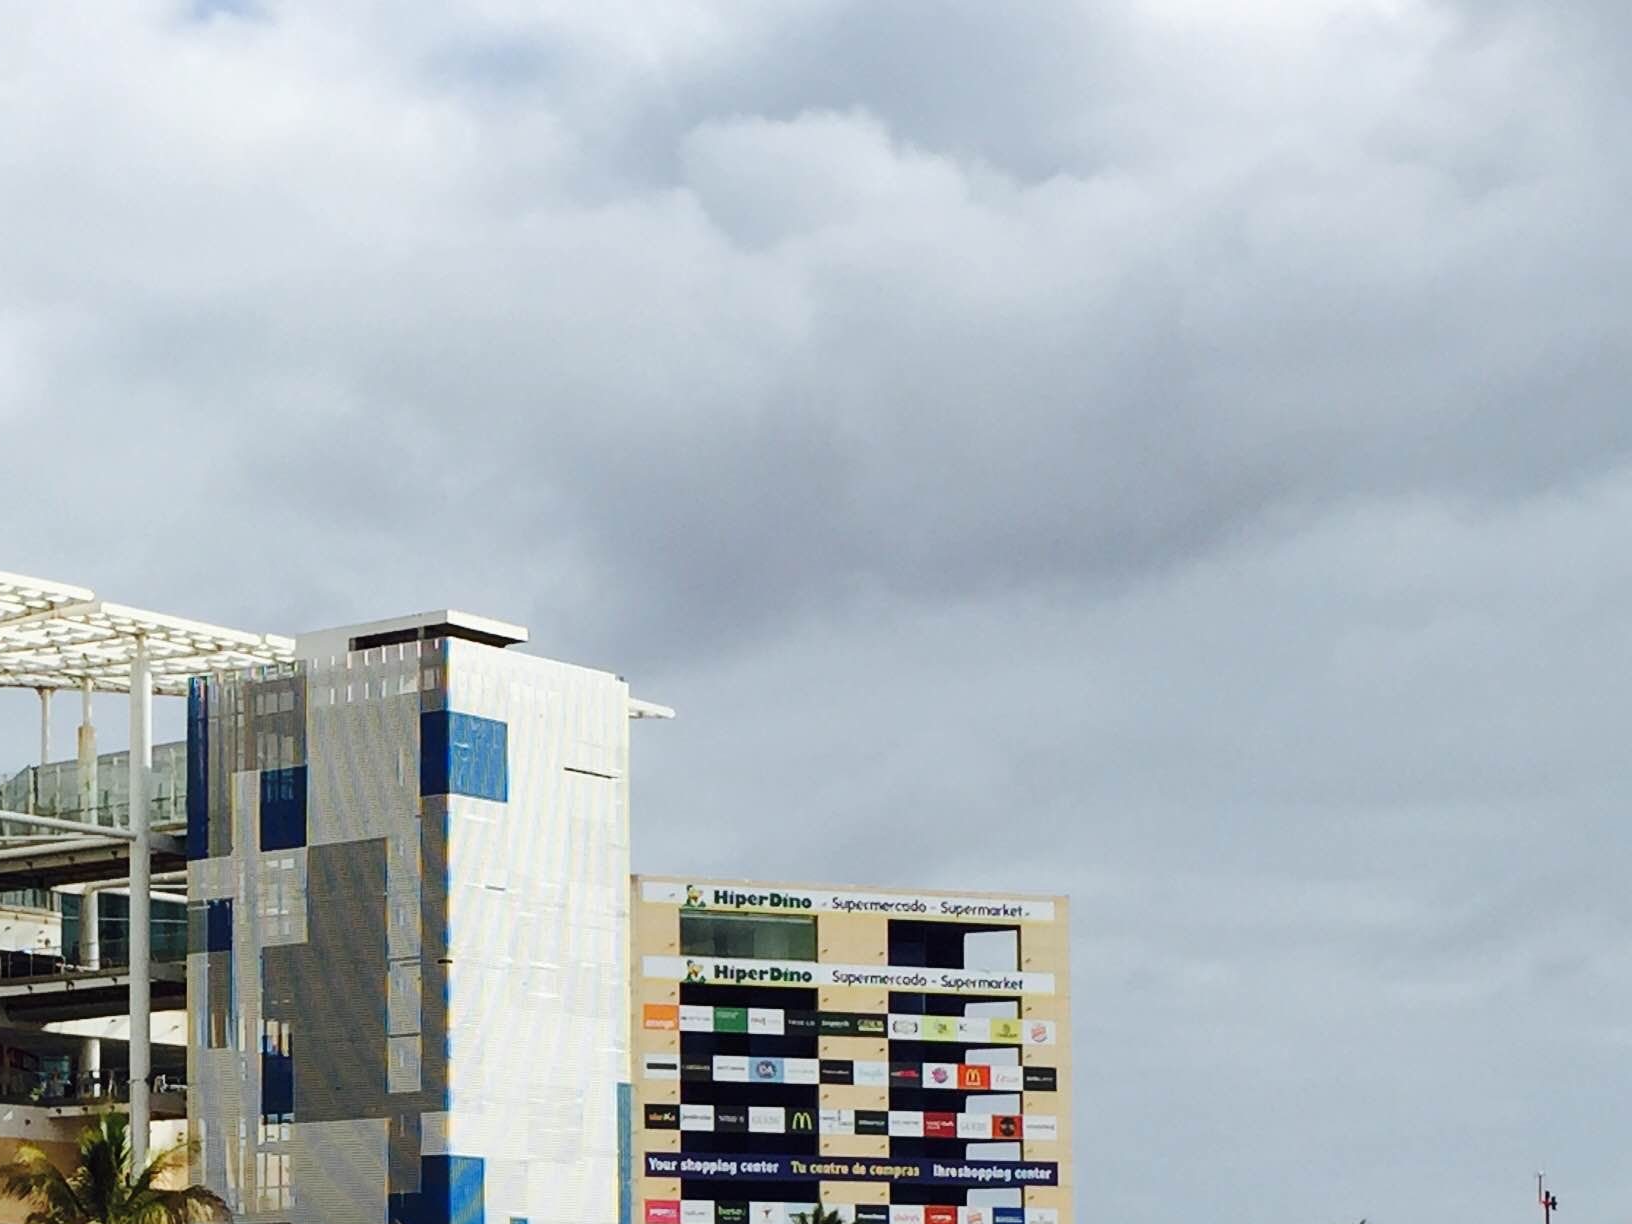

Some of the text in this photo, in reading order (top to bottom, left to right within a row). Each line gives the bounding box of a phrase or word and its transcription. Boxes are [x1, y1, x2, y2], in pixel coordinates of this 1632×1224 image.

[714, 890, 813, 909] HiperDino
[832, 897, 927, 913] Supermercado
[941, 902, 1023, 917] Supermarket
[714, 965, 813, 984] HiperDino
[832, 970, 927, 986] Supermercado
[941, 975, 1024, 990] Supermarket
[648, 1157, 780, 1176] Your shopping center
[790, 1160, 807, 1174] Tu
[852, 1162, 867, 1175] de
[869, 1164, 920, 1178] compras
[1014, 1167, 1053, 1180] center
